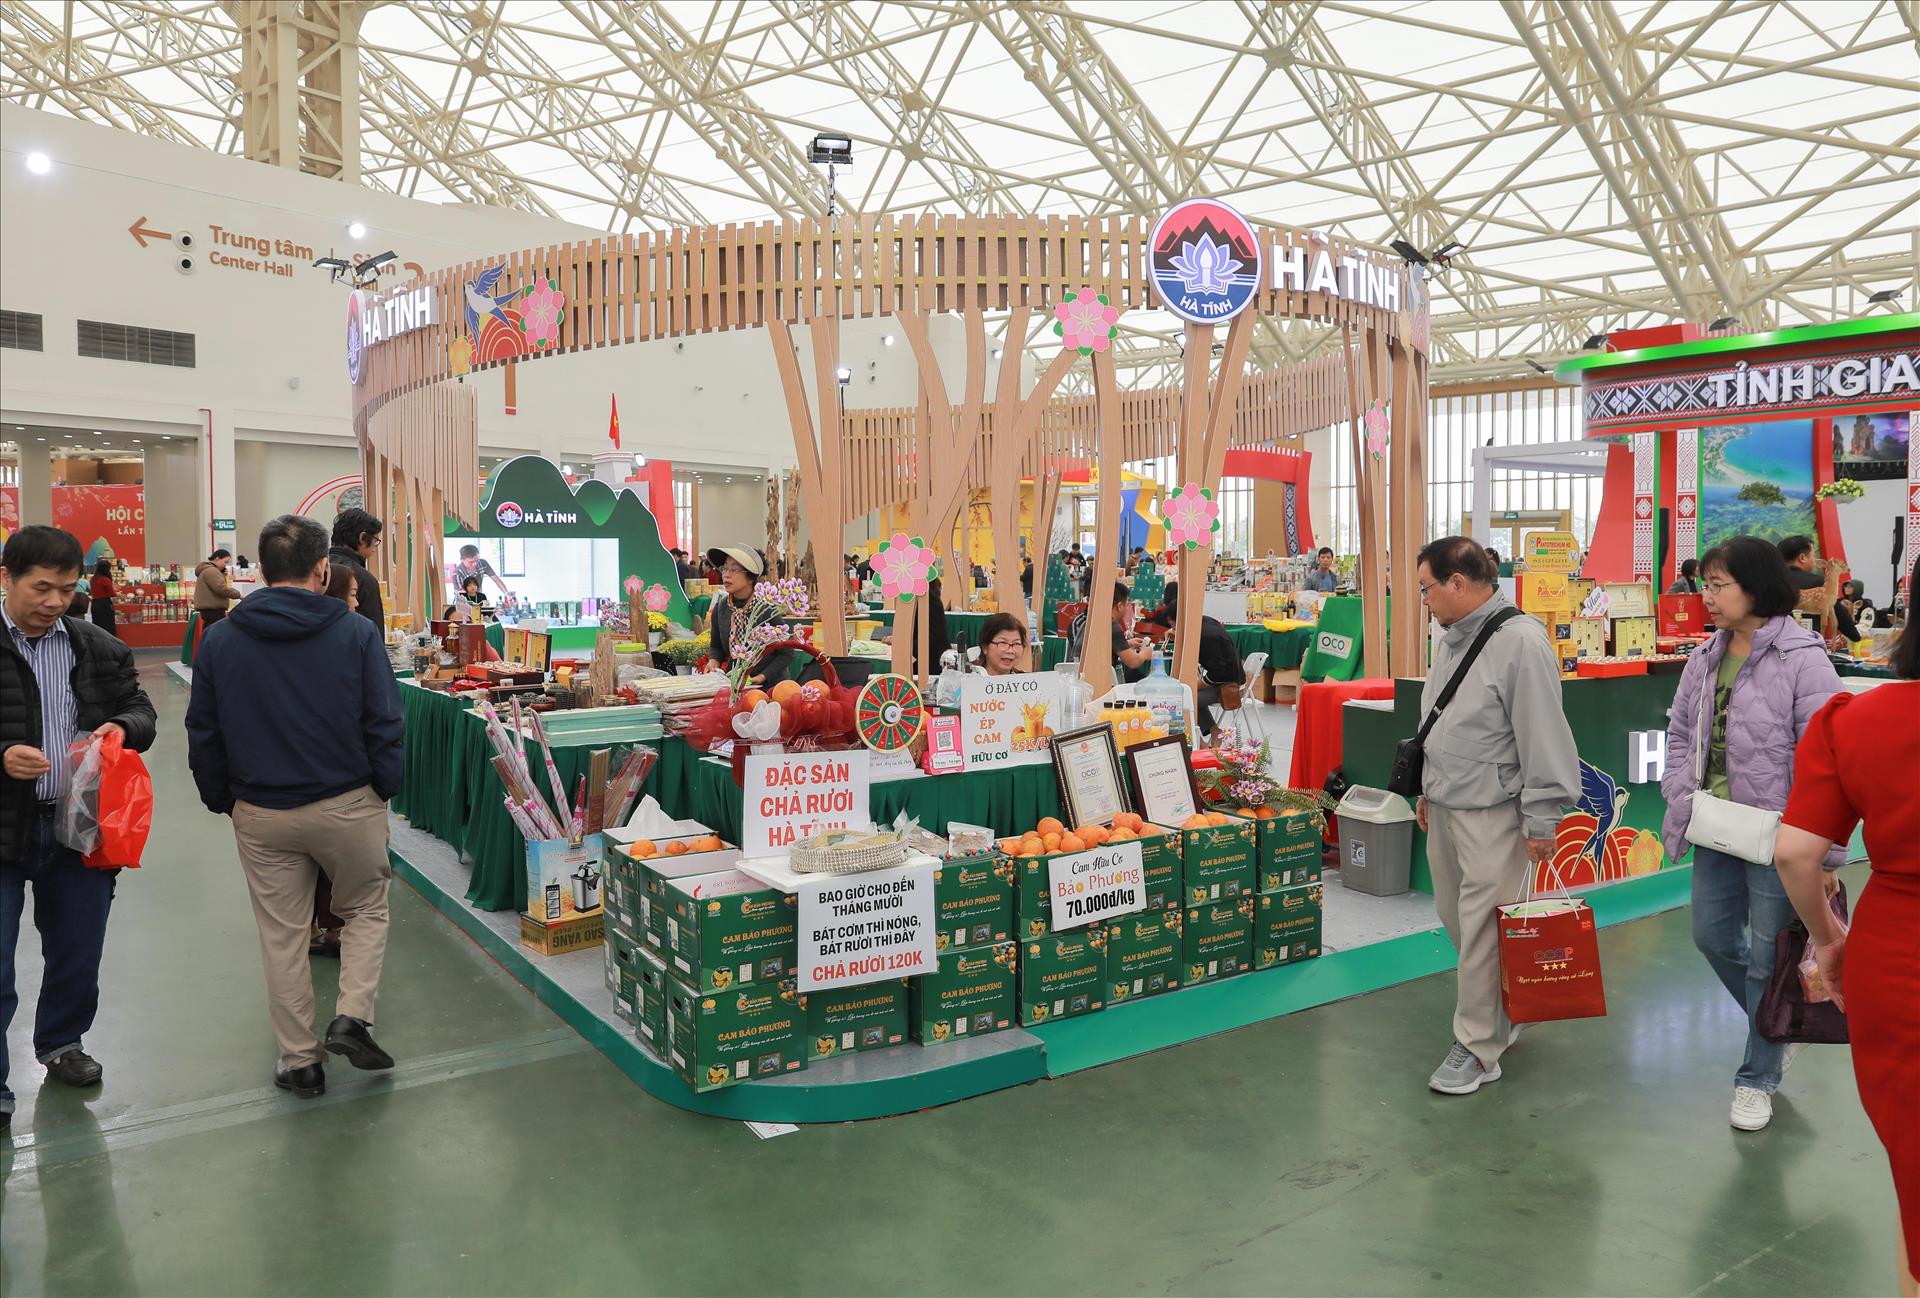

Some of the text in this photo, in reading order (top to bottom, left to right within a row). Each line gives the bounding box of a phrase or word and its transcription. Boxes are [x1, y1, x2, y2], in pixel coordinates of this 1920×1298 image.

[210, 224, 270, 257] Trung
[275, 240, 314, 260] tâm
[210, 252, 260, 272] Center
[264, 260, 293, 278] Hall
[1272, 231, 1399, 313] HÀ TĨNH
[362, 286, 431, 348] HÀ TĨNH
[1180, 296, 1234, 316] HÀ TĨNH
[1708, 354, 1920, 408] TỈNH GIA
[106, 505, 130, 524] HỘI
[524, 508, 544, 524] HÀ
[546, 510, 576, 524] TĨNH
[986, 682, 994, 694] Ở
[996, 681, 1020, 694] ĐÂY
[970, 699, 1006, 714] NƯỚC
[980, 717, 996, 730] ÉP
[974, 732, 1002, 744] CAM
[971, 752, 992, 762] HỮU
[995, 750, 1008, 760] CƠ
[766, 761, 806, 790] ĐẶC
[810, 758, 849, 784] SẢN
[760, 788, 853, 817] CHẢ RƯƠI
[768, 821, 796, 847] HÀ
[1072, 861, 1090, 874] Cam
[1092, 856, 1110, 872] Hữu
[819, 876, 915, 904] BAO GIỜ CHO ĐẾN
[1058, 868, 1140, 898] Bảo Phương
[832, 894, 903, 916] THÁNG MƯỜI
[1066, 888, 1135, 918] 70.000đ/kg
[722, 936, 740, 944] CAM
[813, 915, 921, 942] BÁT CƠM THÌ NÓNG,
[820, 940, 842, 956] BÁT
[844, 936, 872, 952] RƯƠI
[874, 932, 892, 947] THÌ
[812, 950, 923, 982] CHẢ RƯƠI 120K
[826, 1005, 844, 1013] CAM
[718, 1031, 738, 1042] CAM
[739, 1026, 757, 1038] BẢO
[758, 1020, 791, 1033] PHƯƠNG
